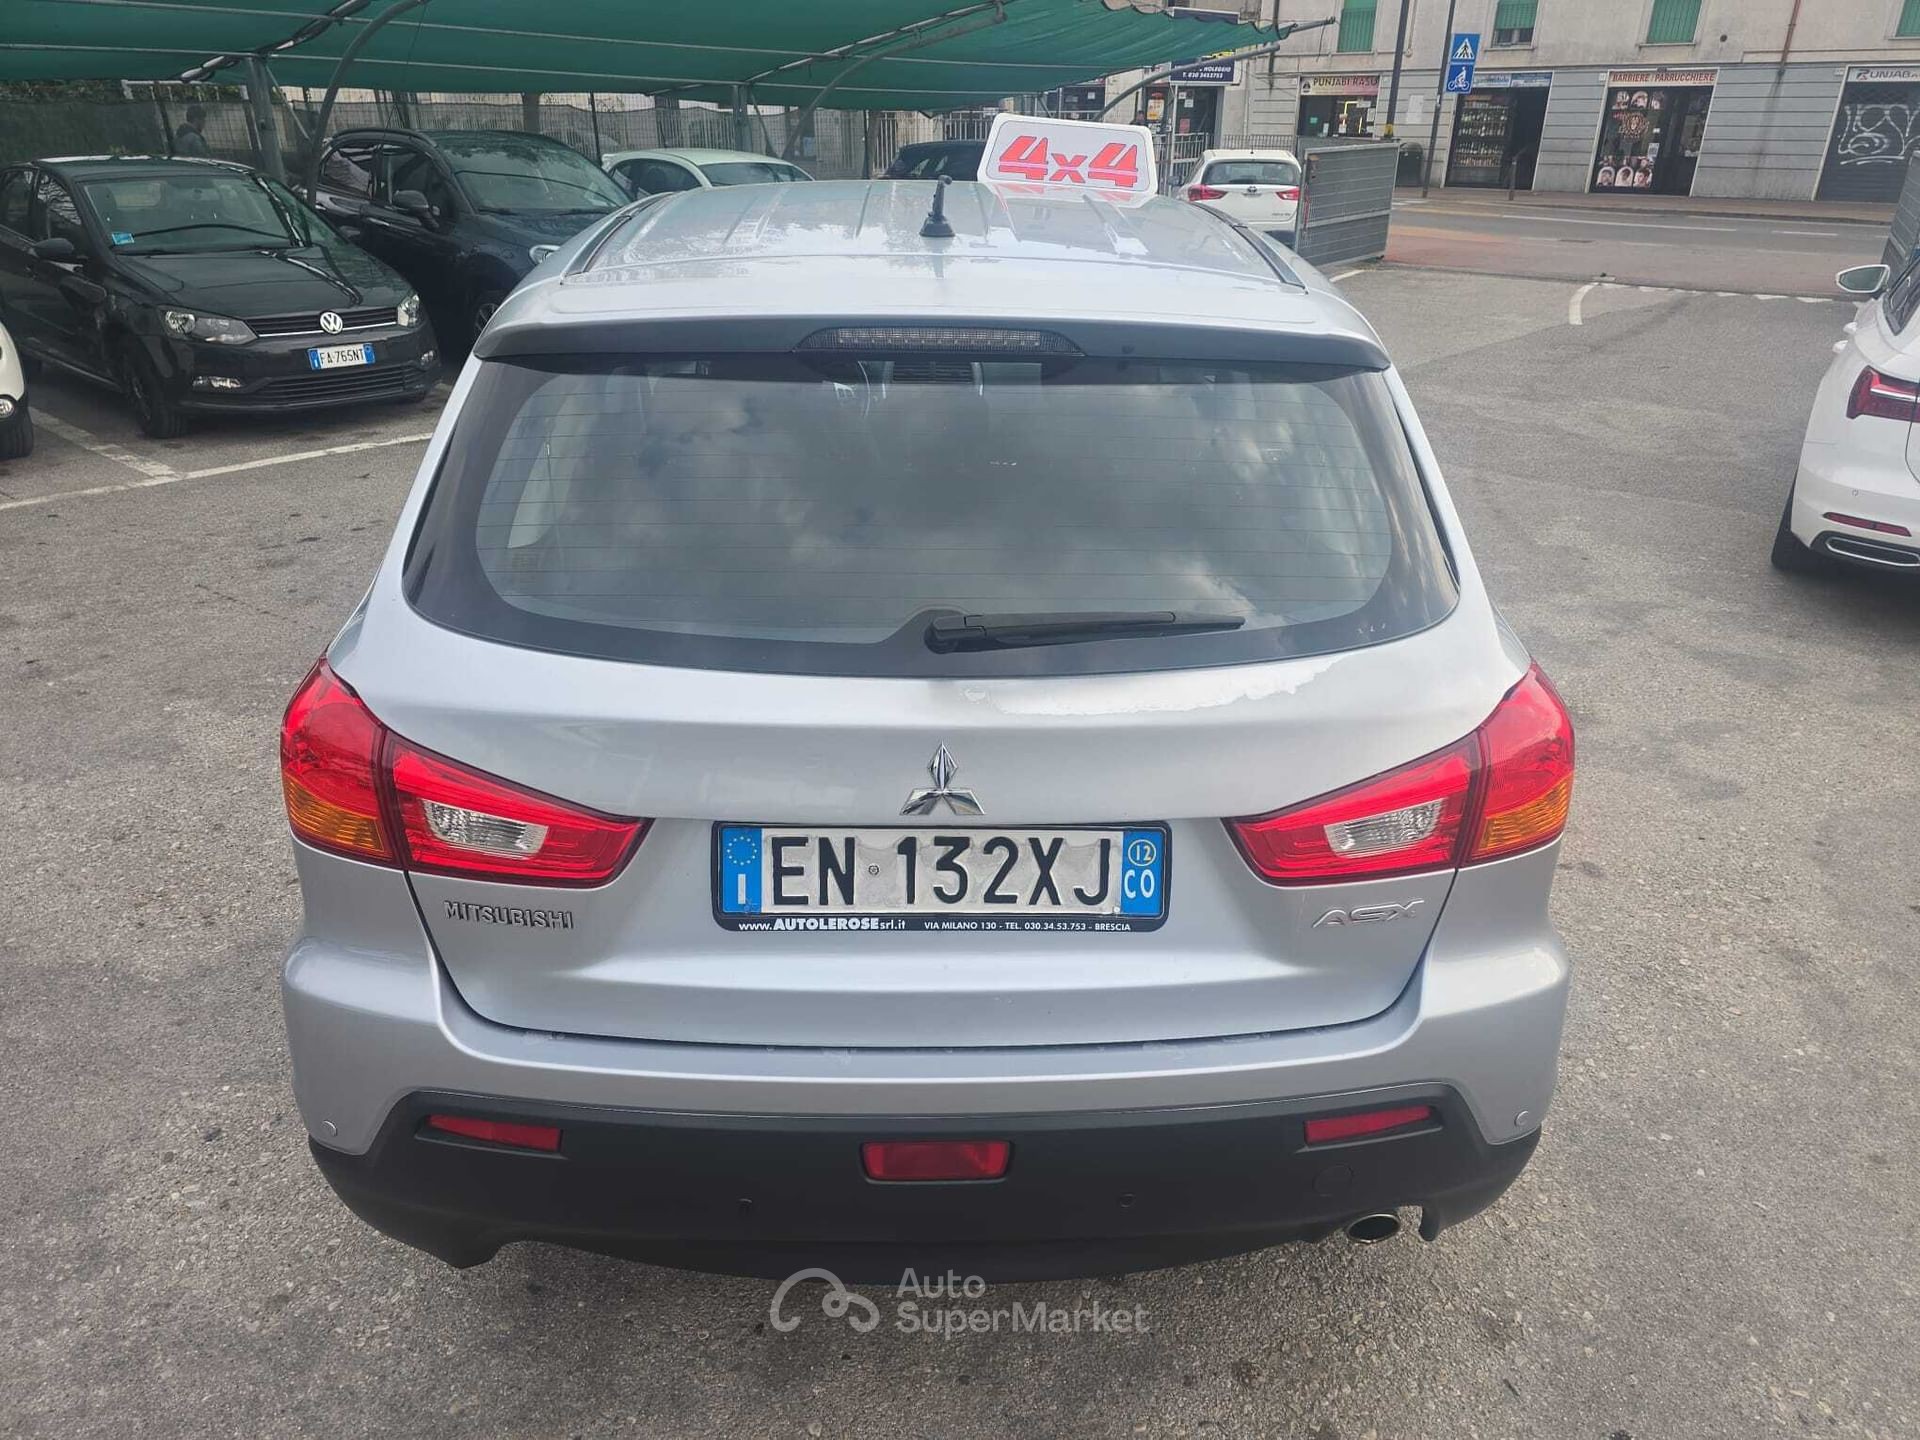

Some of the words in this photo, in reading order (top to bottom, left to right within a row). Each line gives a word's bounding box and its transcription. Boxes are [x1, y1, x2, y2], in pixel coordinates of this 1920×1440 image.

[1313, 75, 1350, 86] PUNJABI
[1612, 73, 1650, 82] BARBIERE
[1654, 71, 1715, 82] PARRUCCHIERE
[998, 135, 1138, 187] 4x4
[320, 352, 333, 364] FA
[335, 348, 364, 362] 765NT
[1135, 844, 1152, 861] 12
[771, 836, 856, 906] EN
[897, 836, 1111, 906] 132XJ
[1124, 869, 1155, 899] CO
[444, 900, 573, 929] MITSUBISHI
[738, 917, 906, 931] www.AUTOLEROSEsrl.it
[924, 921, 940, 930] VIA
[941, 921, 978, 930] MILANO
[980, 921, 997, 930] 130
[1005, 921, 1022, 930] TEL.
[1024, 921, 1087, 931] 030.34.53.753
[1095, 922, 1131, 931] BRESCIA
[1312, 899, 1424, 928] ASX
